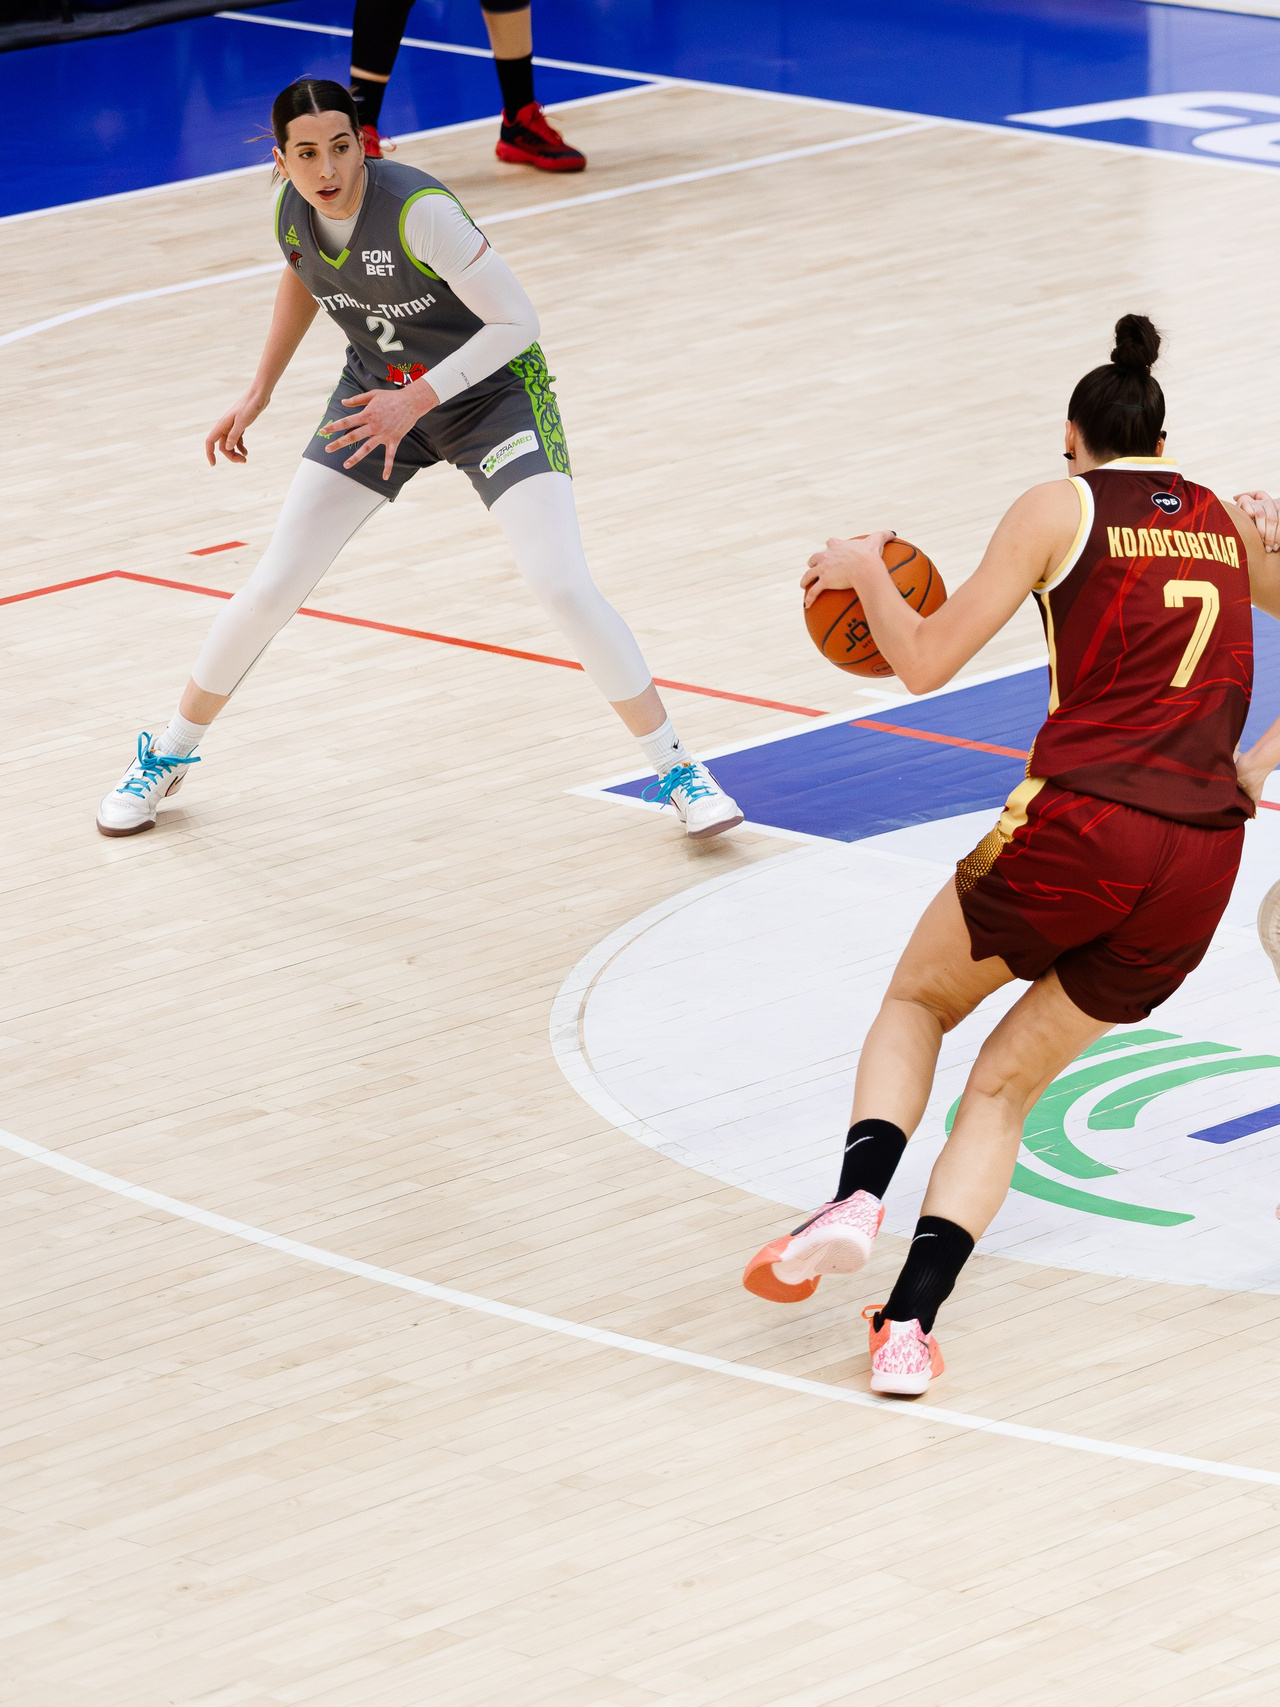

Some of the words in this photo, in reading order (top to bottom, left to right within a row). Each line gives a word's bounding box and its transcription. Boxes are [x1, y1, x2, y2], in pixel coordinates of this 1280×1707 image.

[361, 250, 392, 263] FON
[365, 264, 395, 276] BET
[365, 315, 404, 353] 2
[1155, 497, 1178, 507] РФБ
[1106, 526, 1240, 569] КОЛОСОВСКАЯ
[1163, 579, 1220, 688] 7
